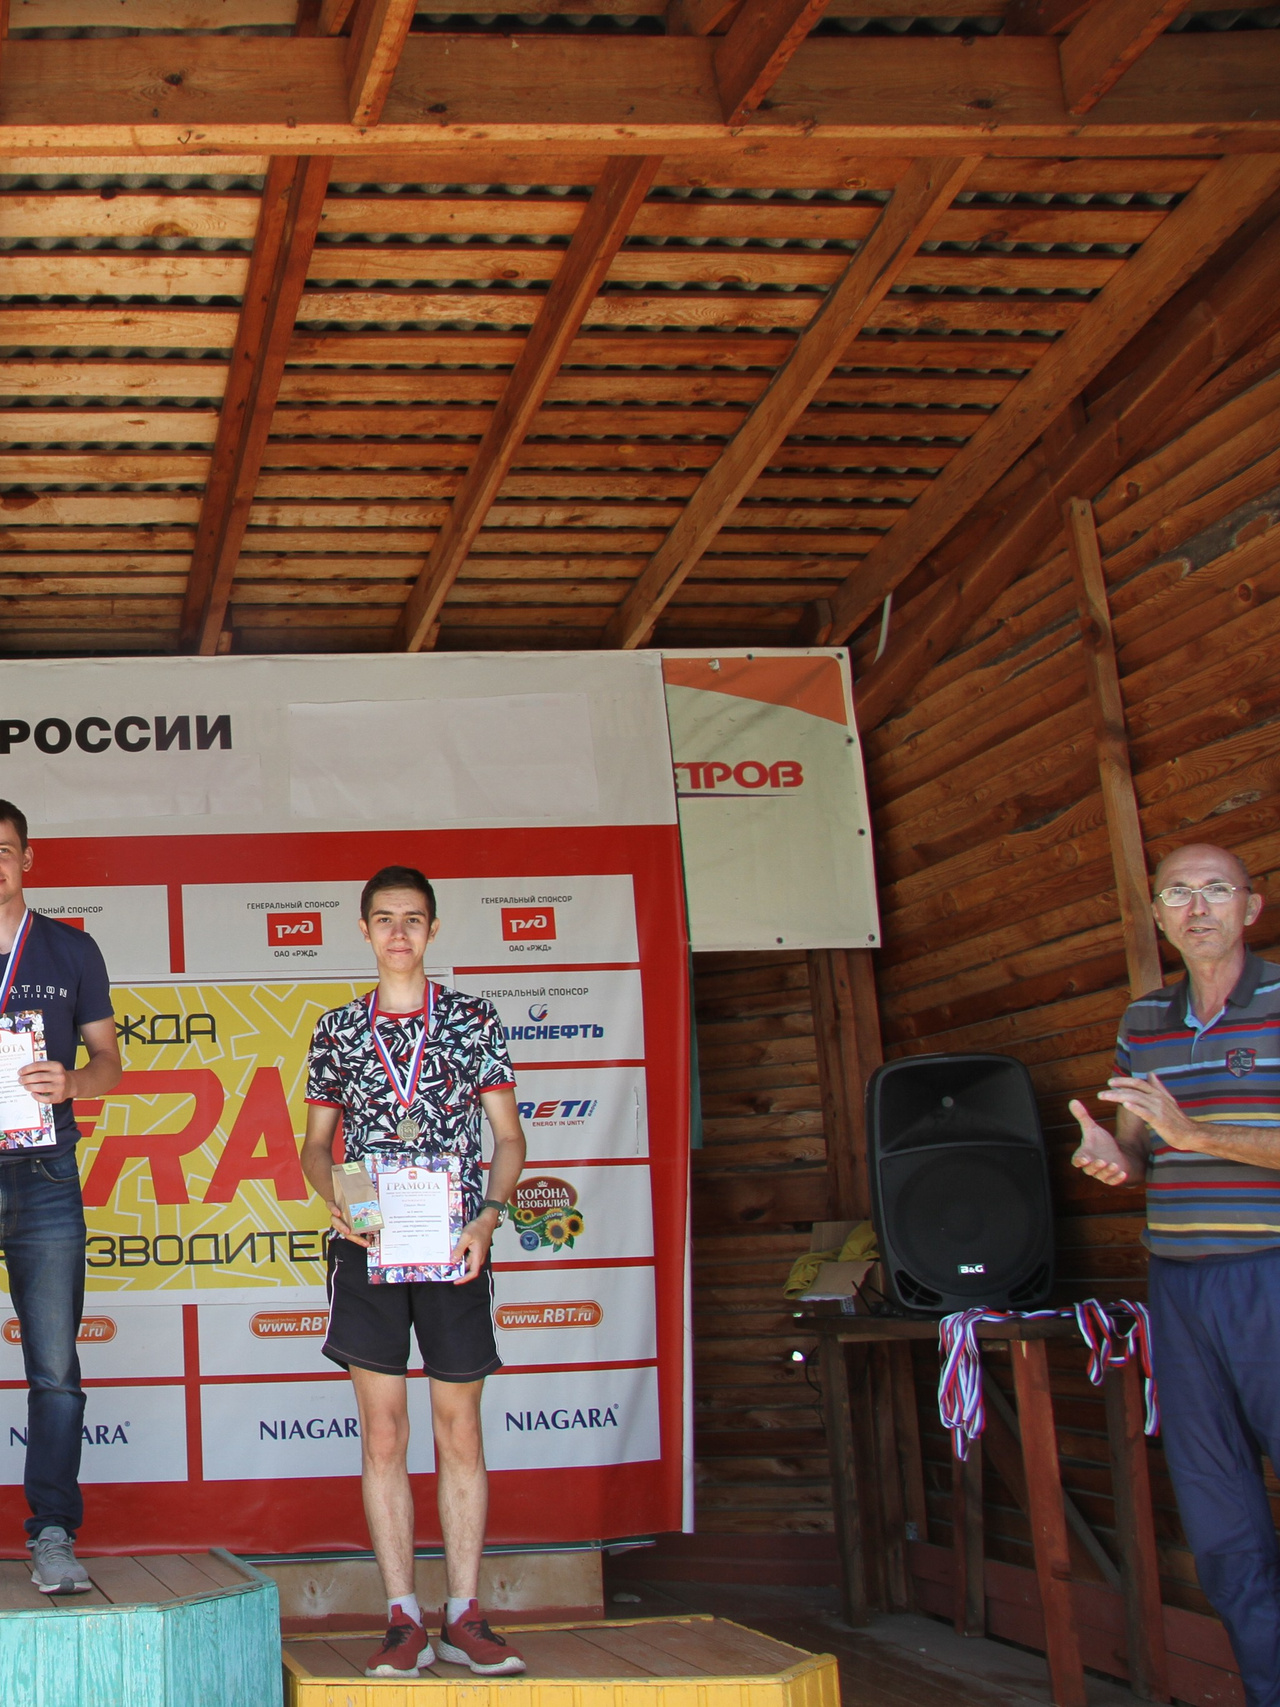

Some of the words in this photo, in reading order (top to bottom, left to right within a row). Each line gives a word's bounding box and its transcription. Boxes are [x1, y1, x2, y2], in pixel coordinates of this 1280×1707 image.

[673, 760, 804, 790] ТРОВ
[246, 900, 303, 910] ГЕНЕРАЛЬНЫЙ
[304, 900, 340, 909] СПОНСОР
[480, 894, 536, 904] ГЕНЕРАЛЬНЫЙ
[537, 894, 573, 904] СПОНСОР
[27, 905, 66, 915] РАЛЬНЫЙ
[67, 906, 104, 915] СПОНСОР
[273, 950, 290, 958] ОАО
[508, 944, 525, 952] ОАО
[481, 986, 546, 998] ГЕНЕРАЛЬНЫЙ
[548, 987, 589, 997] СПОНСОР
[114, 1012, 217, 1045] ЖДА
[503, 1023, 605, 1041] АНСНЕФТЬ
[516, 1099, 592, 1120] RETI
[386, 1181, 440, 1191] ГРАМОТА
[516, 1187, 569, 1201] КОРОНА
[517, 1198, 570, 1209] ИЗОБИЛИЯ
[86, 1230, 329, 1267] ЗВОДИТЕ
[502, 1307, 592, 1325] www.RBT.ru
[505, 1407, 618, 1432] NIAGARA
[260, 1417, 359, 1441] NIAGAR
